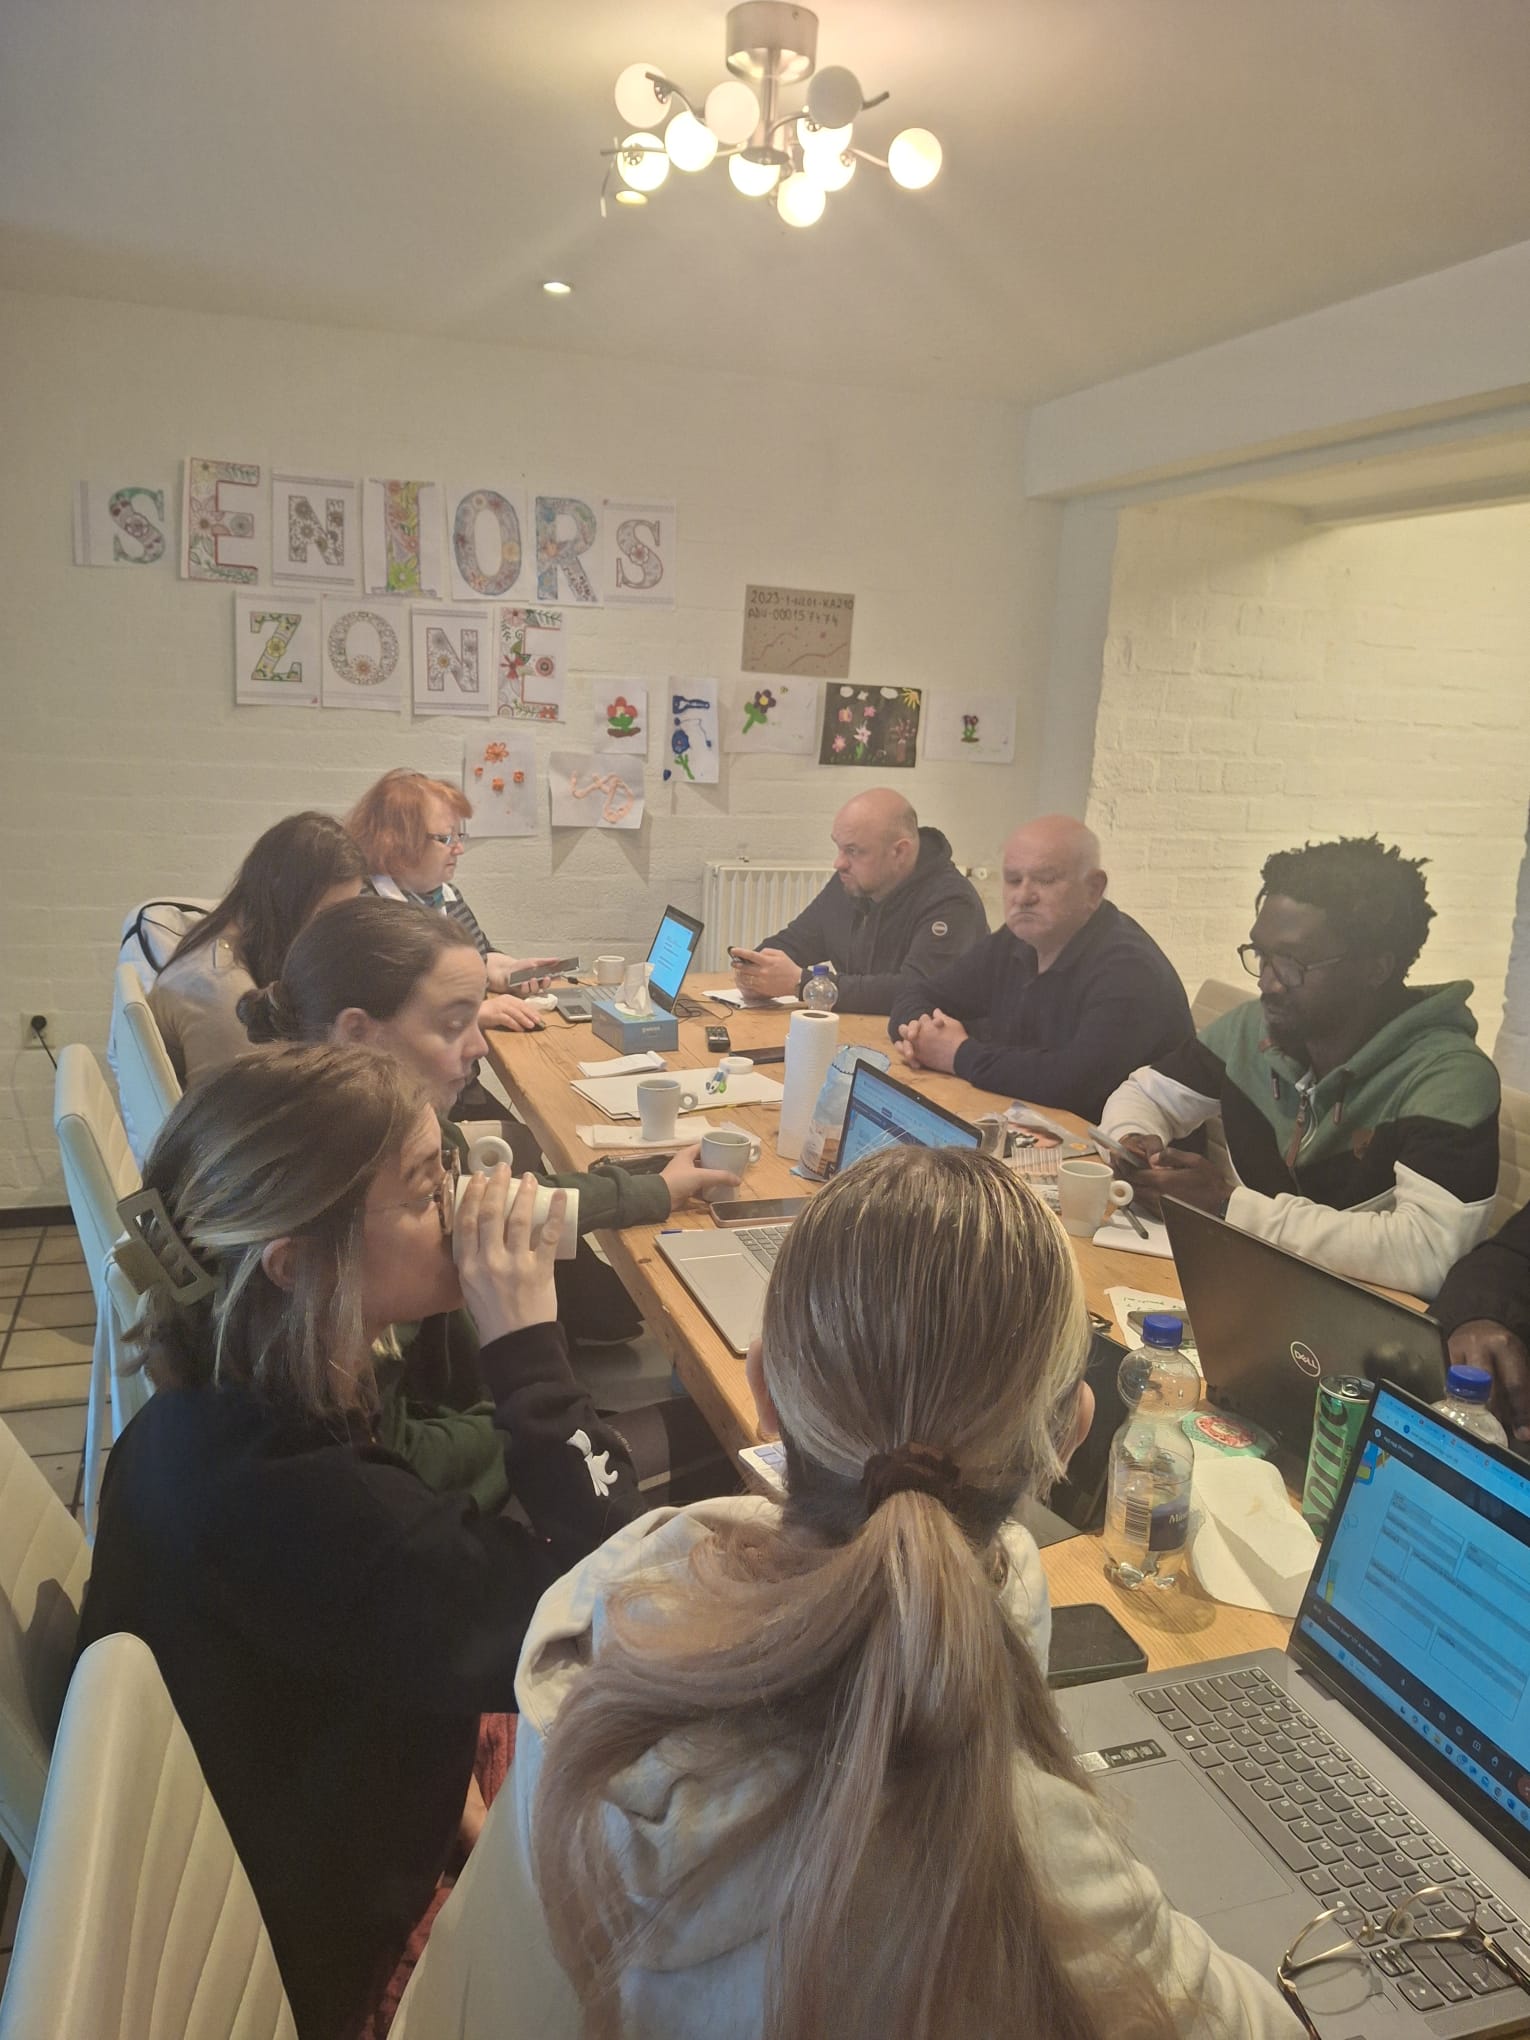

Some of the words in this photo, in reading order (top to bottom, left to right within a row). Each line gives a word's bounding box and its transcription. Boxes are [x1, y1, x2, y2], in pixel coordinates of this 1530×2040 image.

[108, 457, 664, 601] SENIORS
[250, 607, 563, 720] ZONE
[1293, 1350, 1318, 1369] DELL
